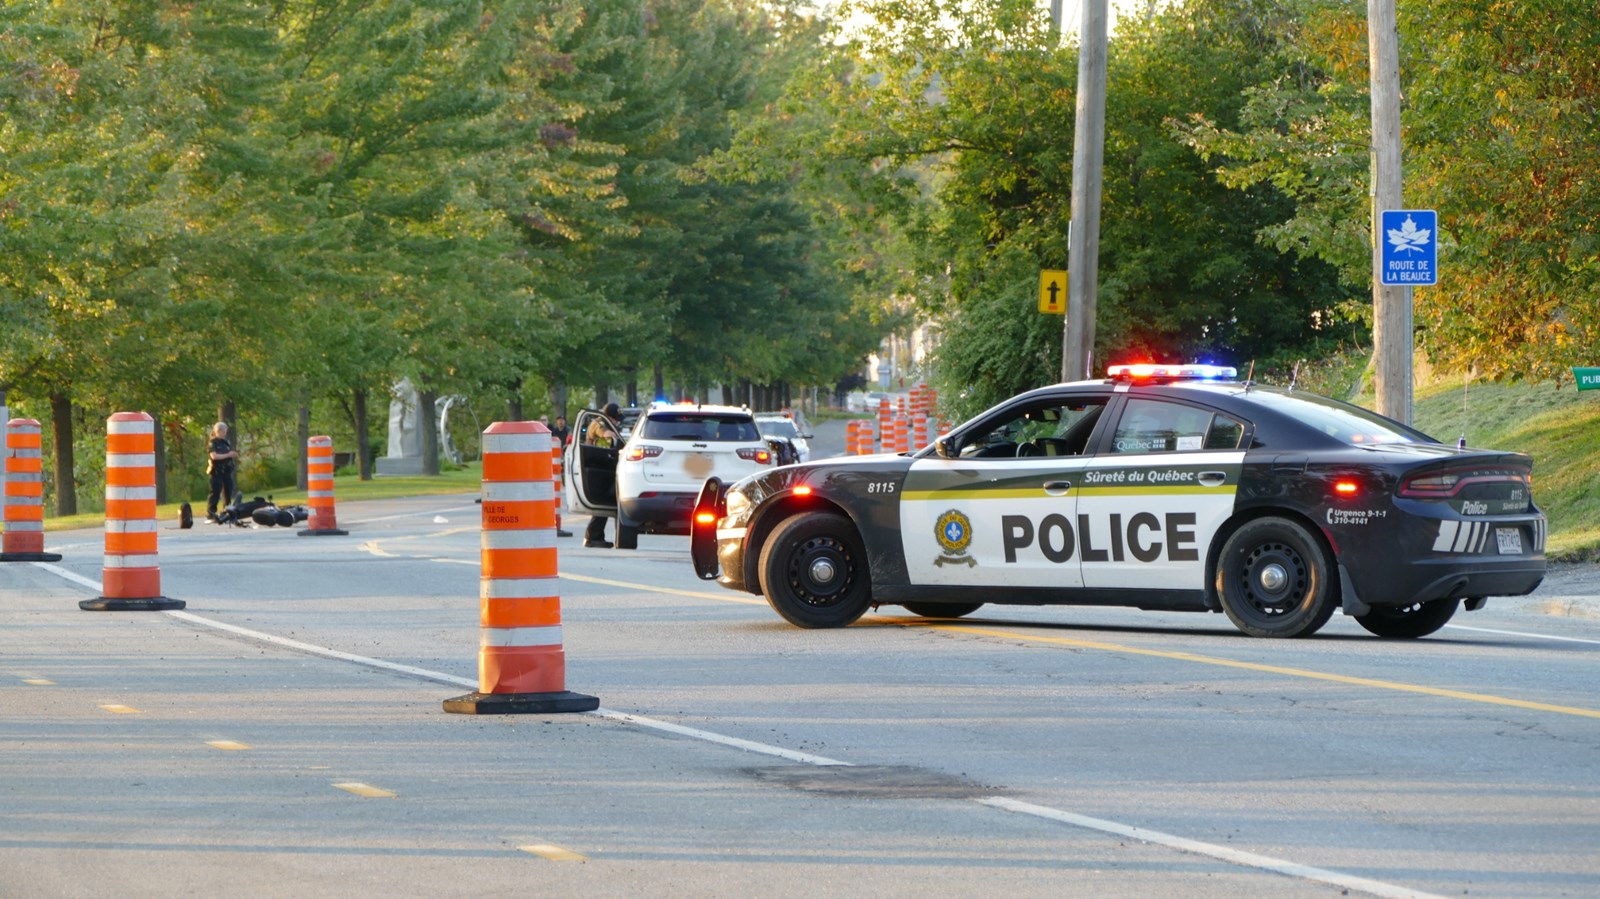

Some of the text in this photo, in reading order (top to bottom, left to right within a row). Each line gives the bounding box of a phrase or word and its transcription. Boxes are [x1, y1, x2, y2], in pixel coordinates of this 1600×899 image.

[1389, 260, 1429, 270] ROUTE DE
[1386, 271, 1431, 281] LA BEAUCE
[1085, 470, 1194, 483] Sûreté du Québec
[867, 482, 895, 493] 8115
[1461, 500, 1488, 515] Police
[1334, 509, 1387, 518] Urgence 9-1-1
[1334, 517, 1368, 525] 310-4141
[1001, 511, 1199, 563] POLICE
